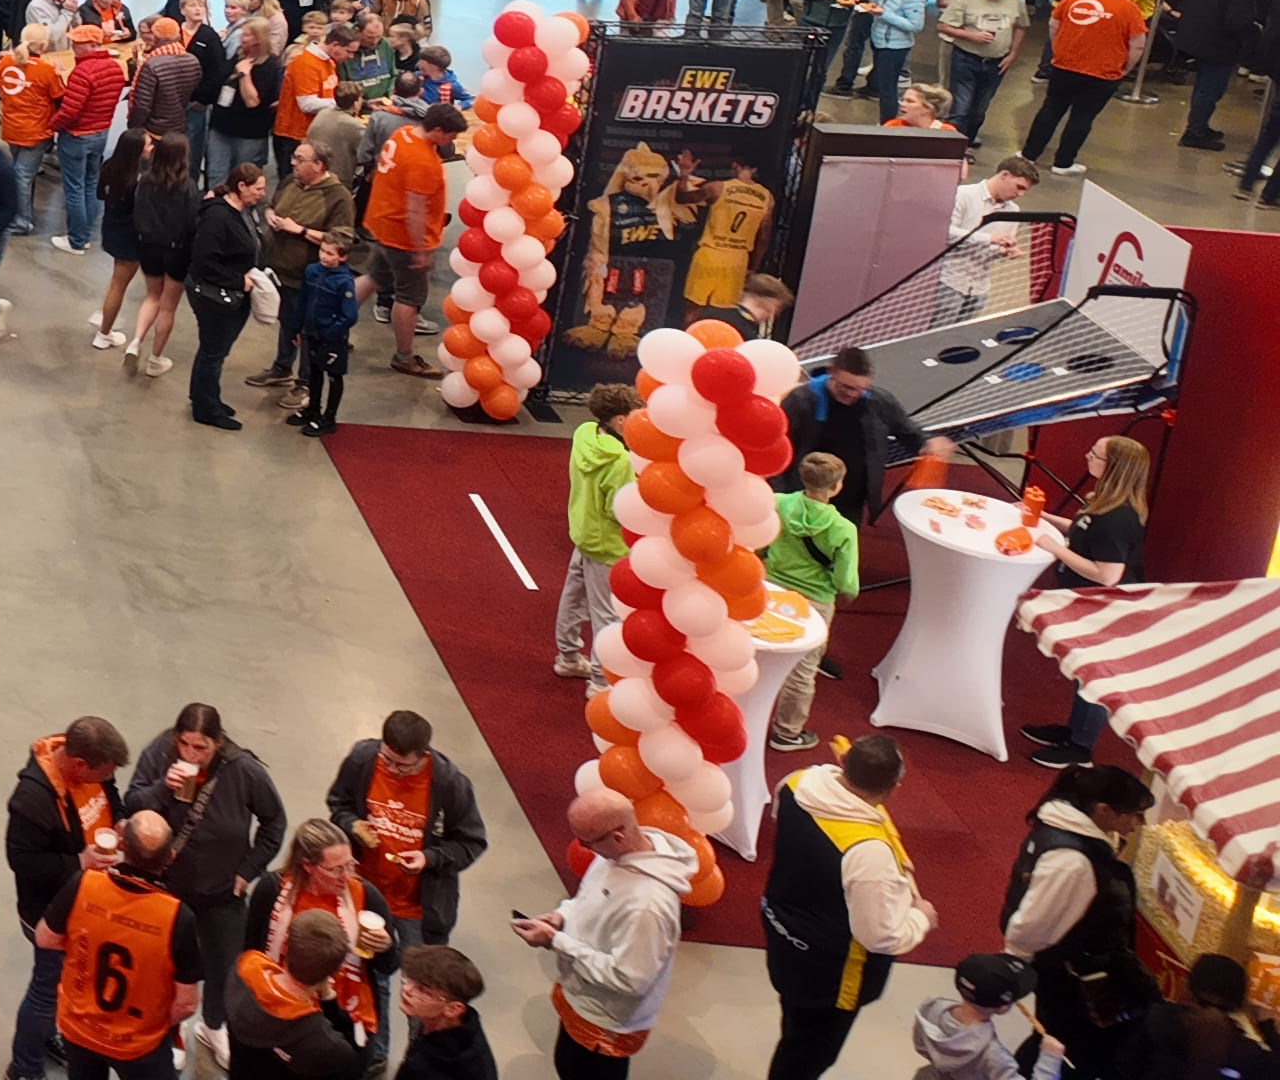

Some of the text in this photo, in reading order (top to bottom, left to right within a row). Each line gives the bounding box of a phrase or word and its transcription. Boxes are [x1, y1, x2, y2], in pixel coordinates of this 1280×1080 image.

[681, 70, 731, 90] EWE
[620, 88, 776, 125] BASKETS
[620, 224, 660, 245] EWE
